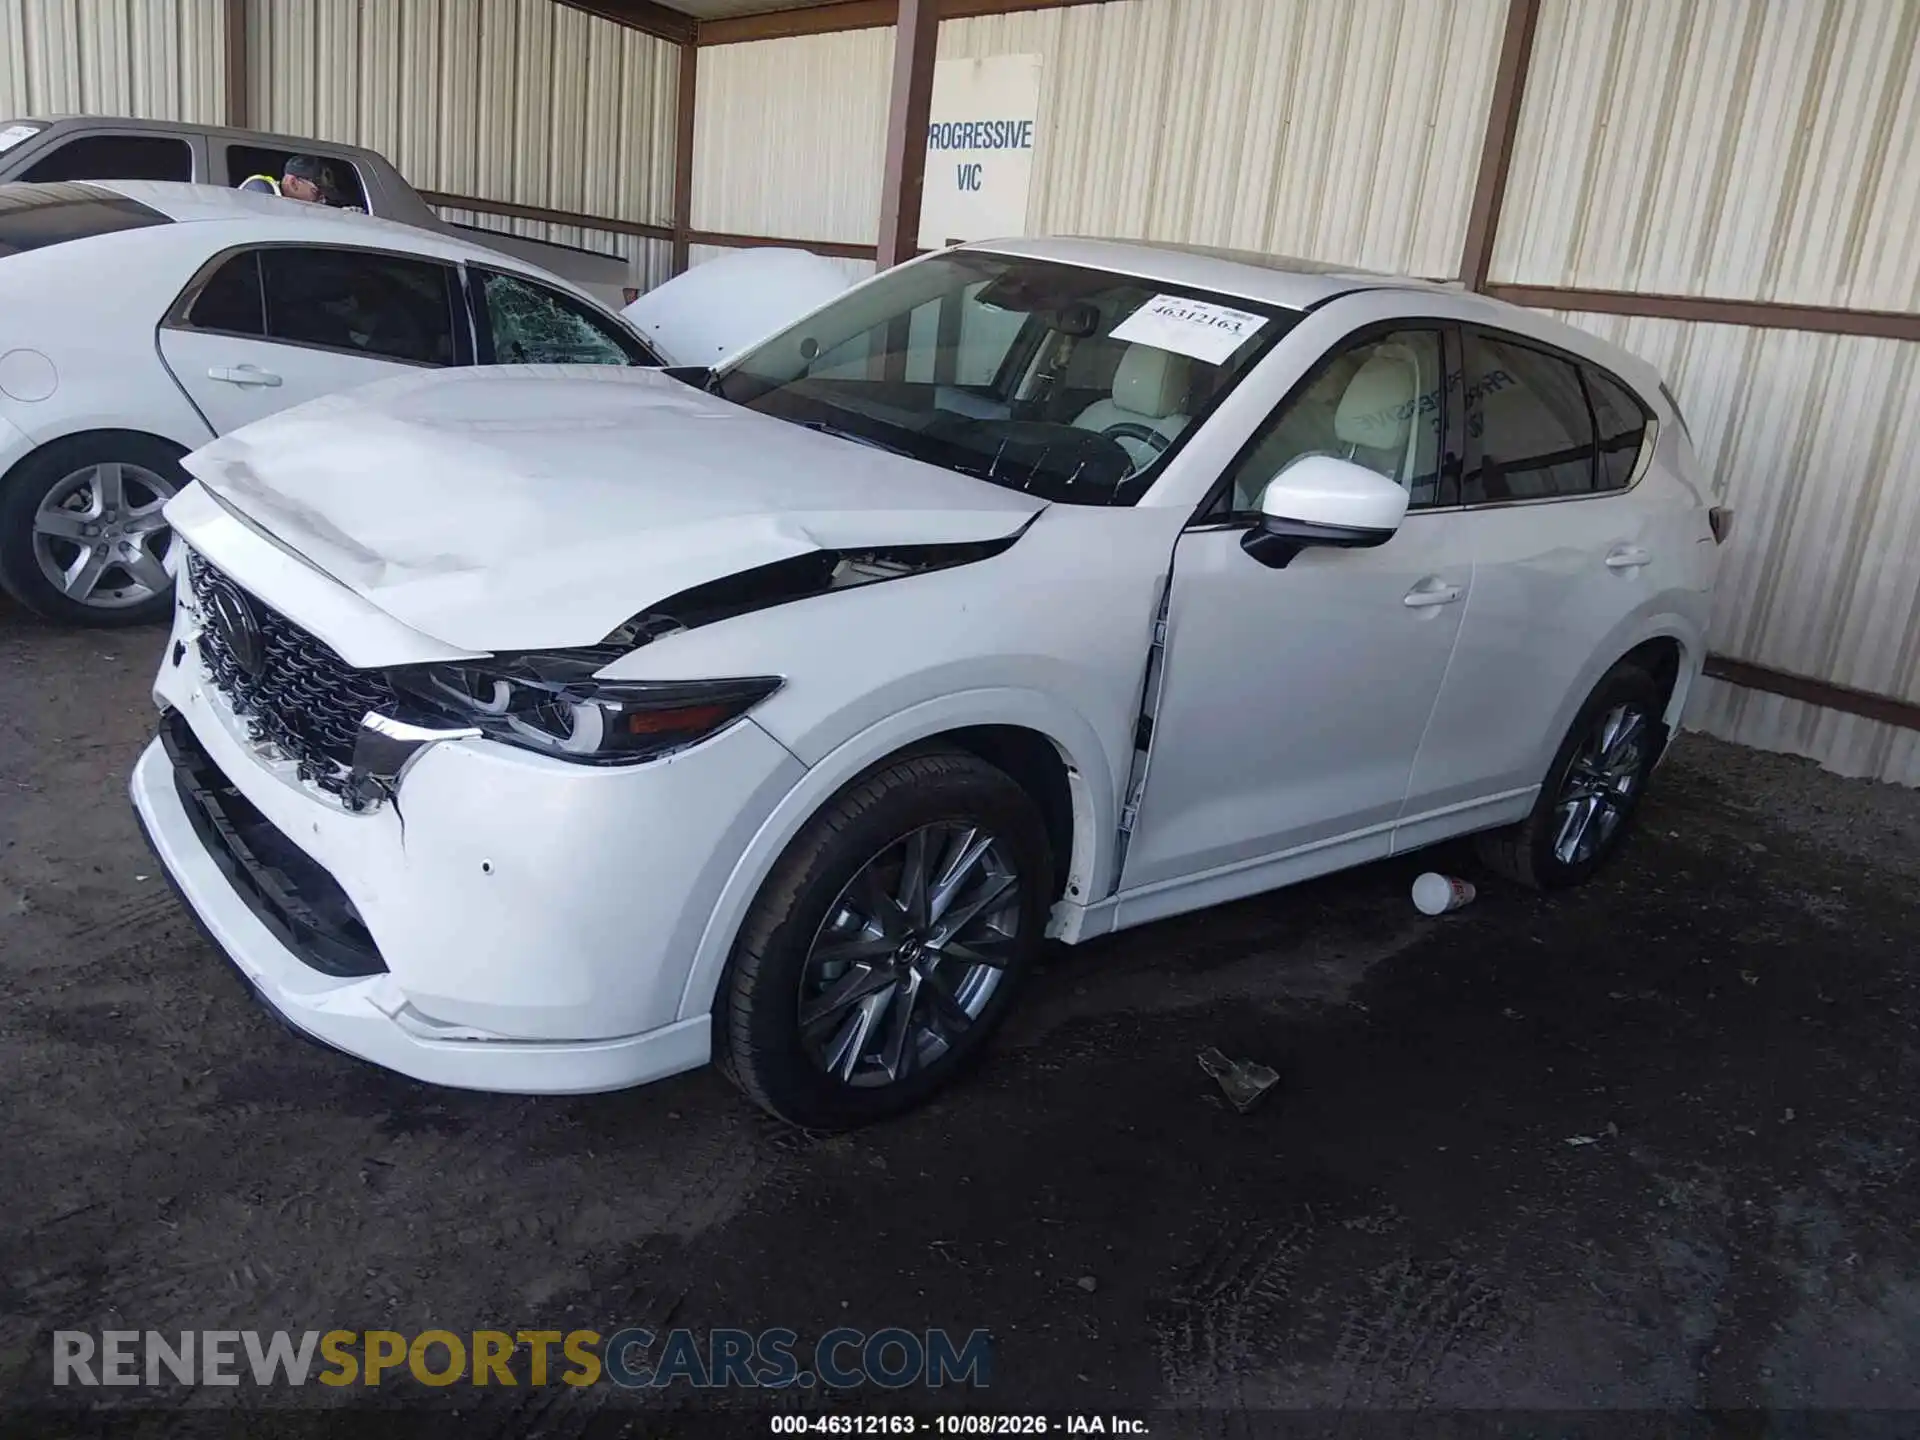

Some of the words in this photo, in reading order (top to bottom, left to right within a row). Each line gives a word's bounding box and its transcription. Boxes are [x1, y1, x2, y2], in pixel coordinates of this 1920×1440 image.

[927, 120, 1033, 149] ROGRESSIVE
[957, 163, 982, 191] VIC
[1152, 306, 1243, 335] 46312163
